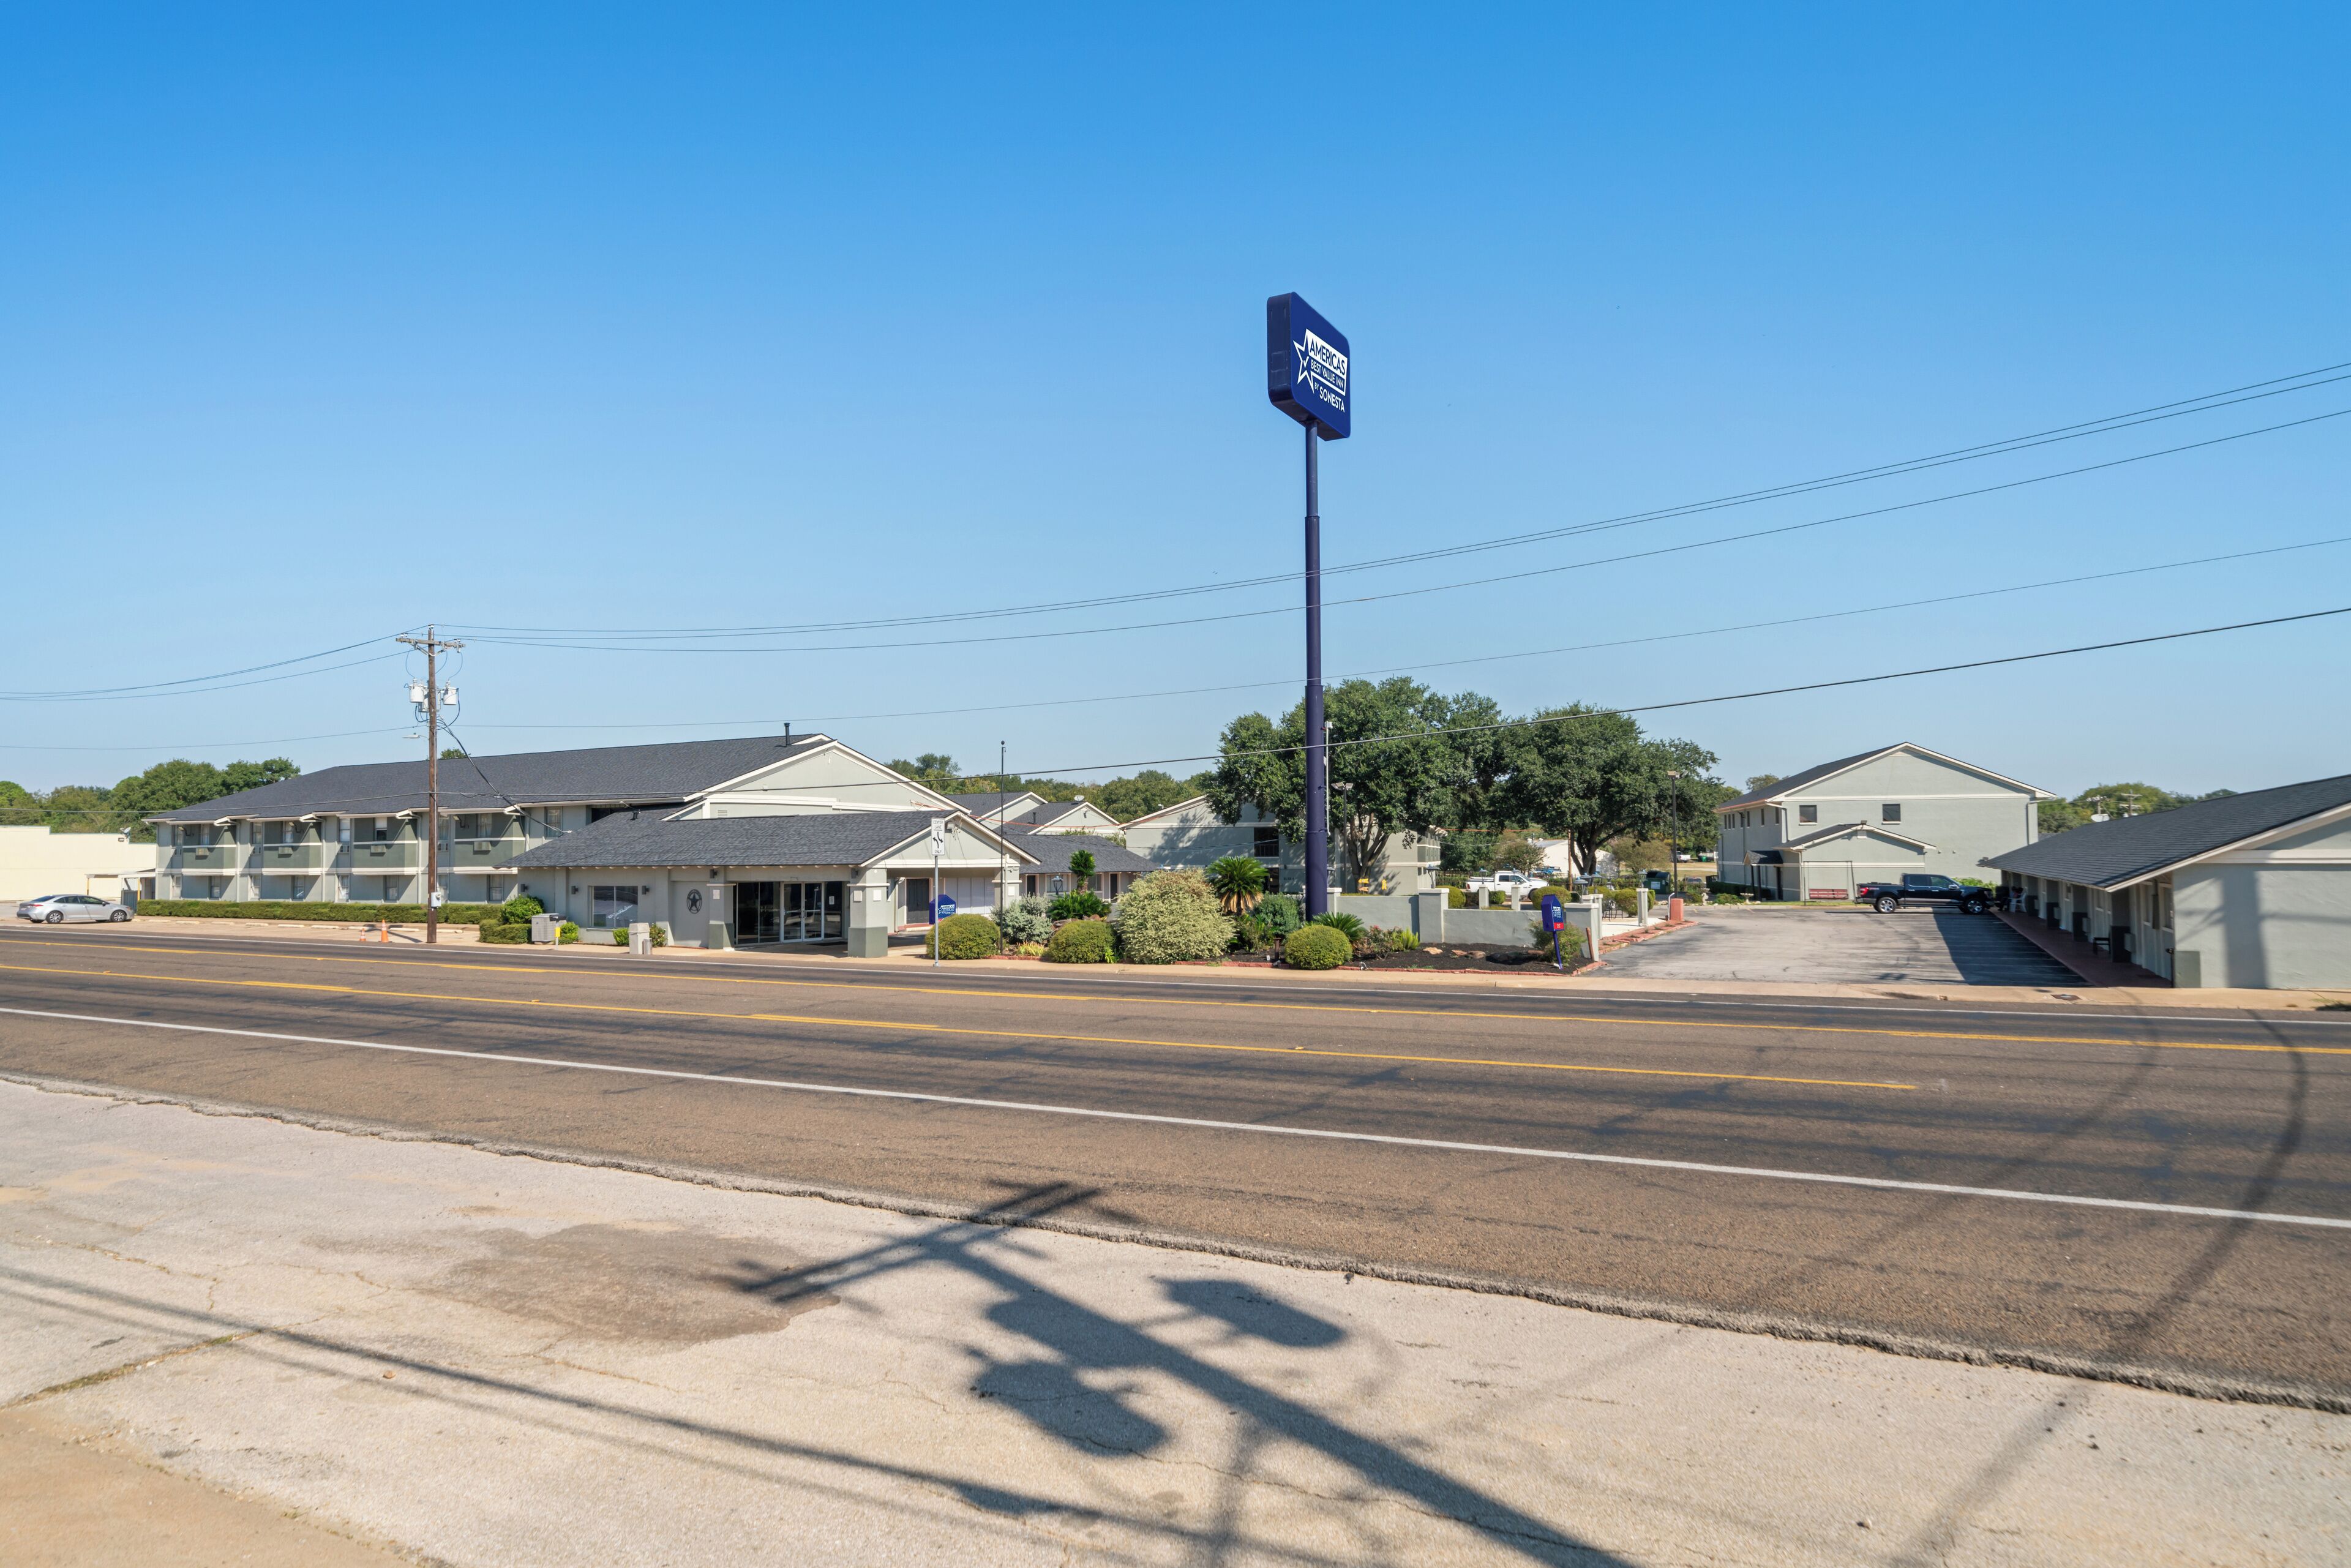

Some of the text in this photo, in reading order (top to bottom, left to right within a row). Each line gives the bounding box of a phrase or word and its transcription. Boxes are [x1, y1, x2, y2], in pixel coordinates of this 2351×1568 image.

[1310, 337, 1346, 376] AMERICAS
[1311, 359, 1344, 389] BEST VALUE INN
[1314, 381, 1345, 413] BY SONESTA
